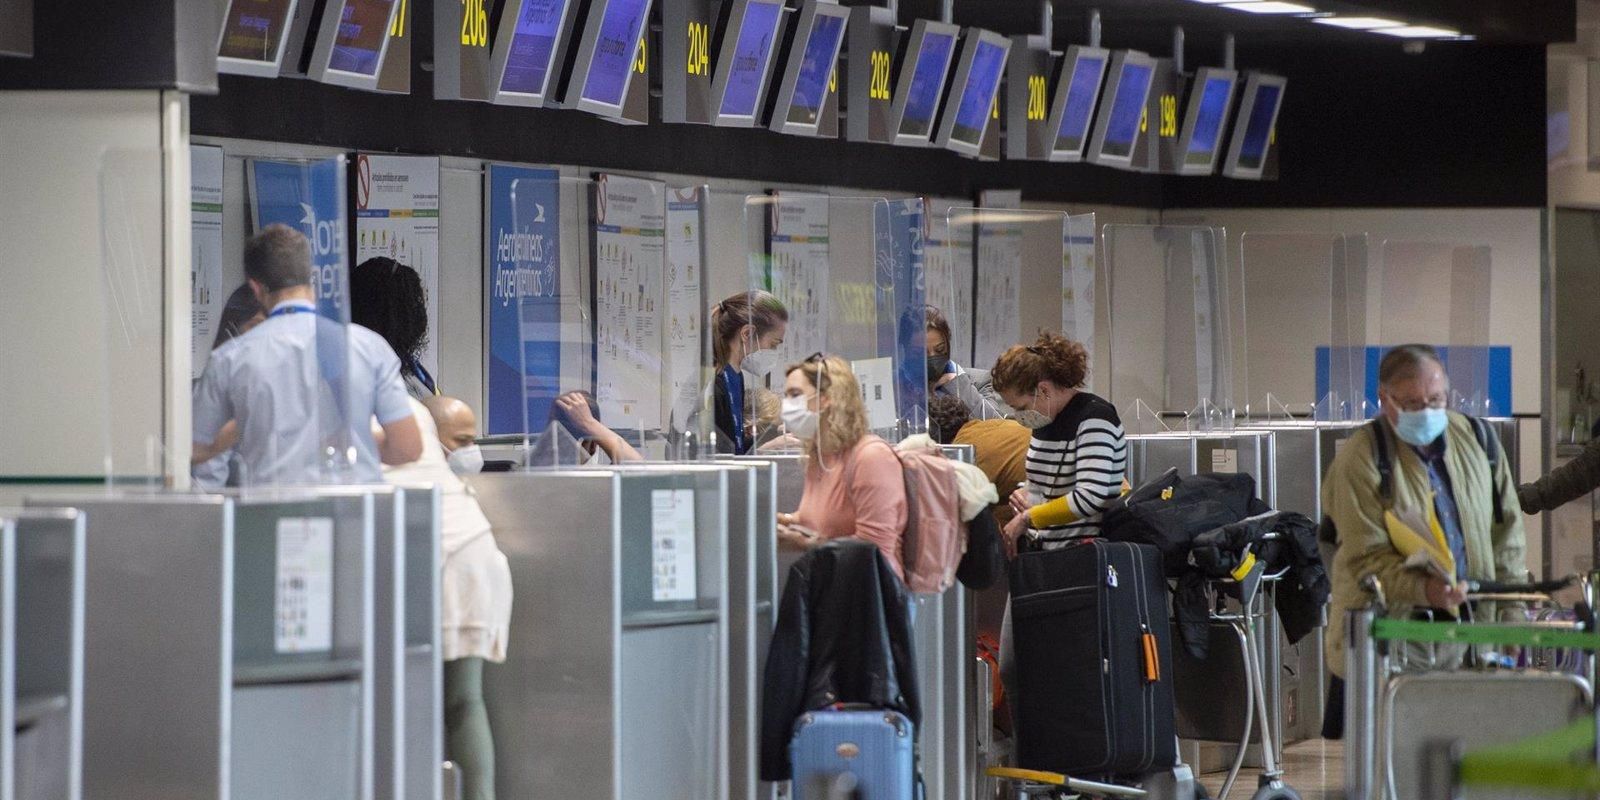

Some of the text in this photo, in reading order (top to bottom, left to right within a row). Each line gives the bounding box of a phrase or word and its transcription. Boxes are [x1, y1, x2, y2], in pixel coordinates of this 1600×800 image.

[461, 0, 488, 47] 206
[687, 22, 709, 76] 204
[870, 52, 890, 100] 202
[1028, 76, 1046, 120] 200
[1160, 96, 1176, 136] 198
